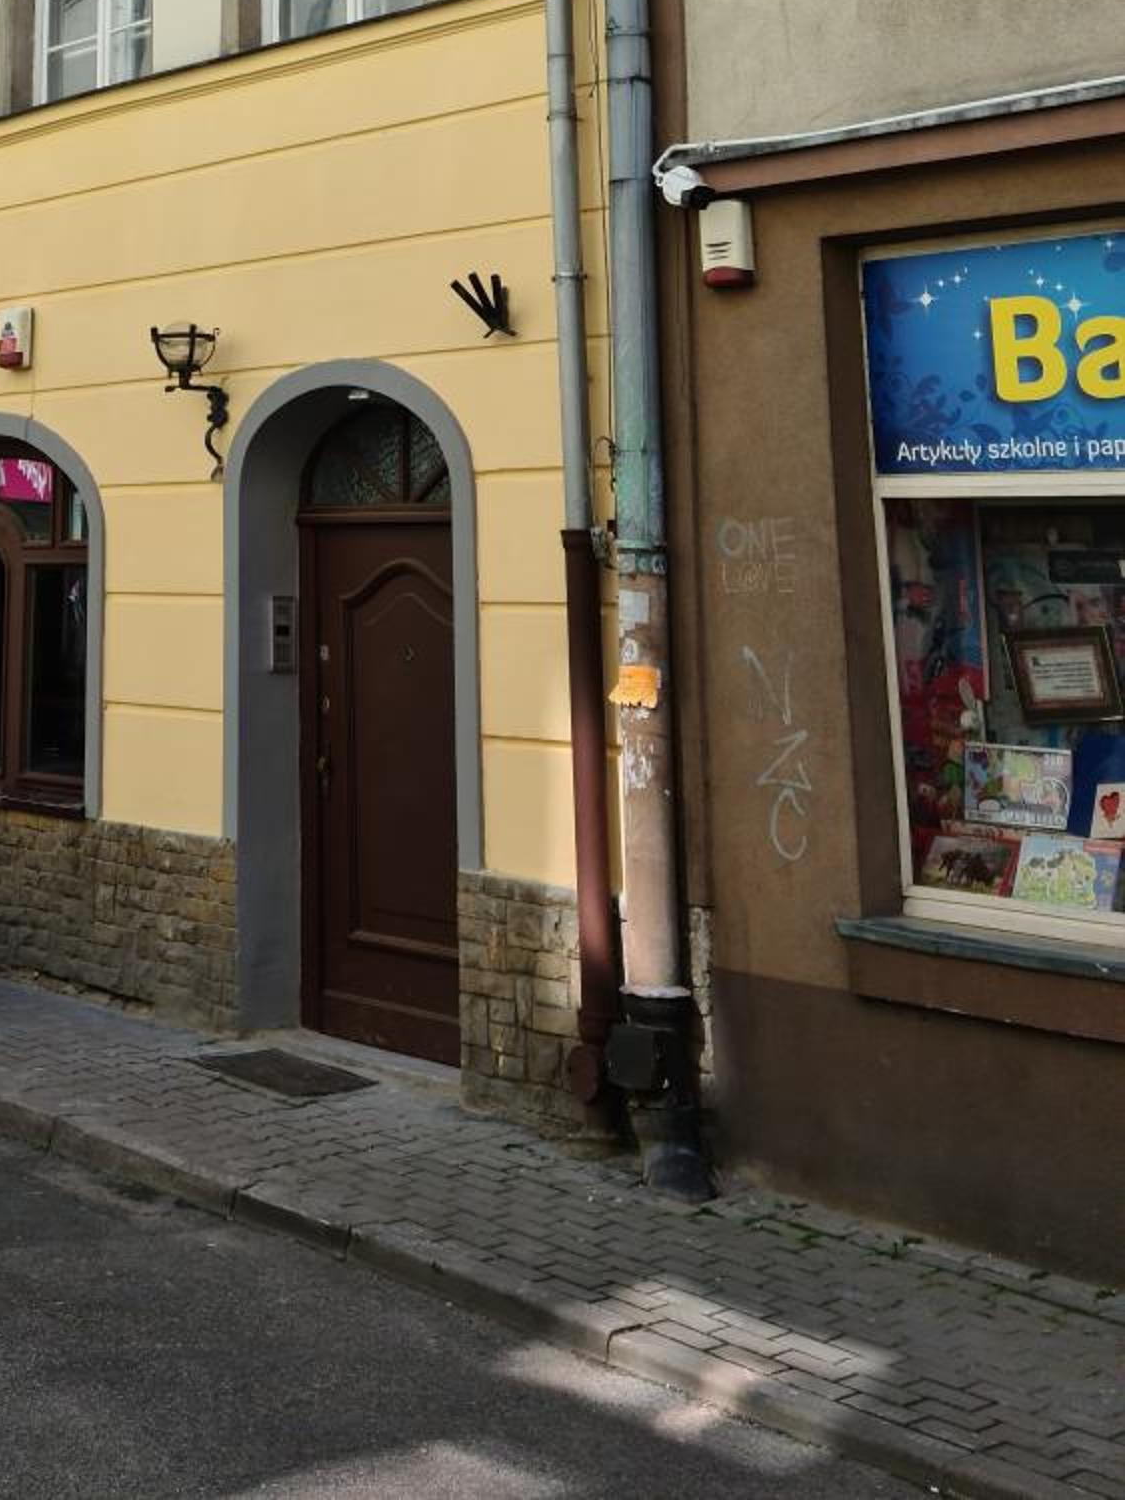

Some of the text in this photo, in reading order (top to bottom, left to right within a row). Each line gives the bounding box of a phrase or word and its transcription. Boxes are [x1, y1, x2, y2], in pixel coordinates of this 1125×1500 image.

[990, 295, 1125, 402] Ba
[897, 439, 982, 466] Artykuły
[988, 436, 1067, 460] szkolne
[1074, 435, 1080, 456] i
[717, 517, 796, 562] ONE
